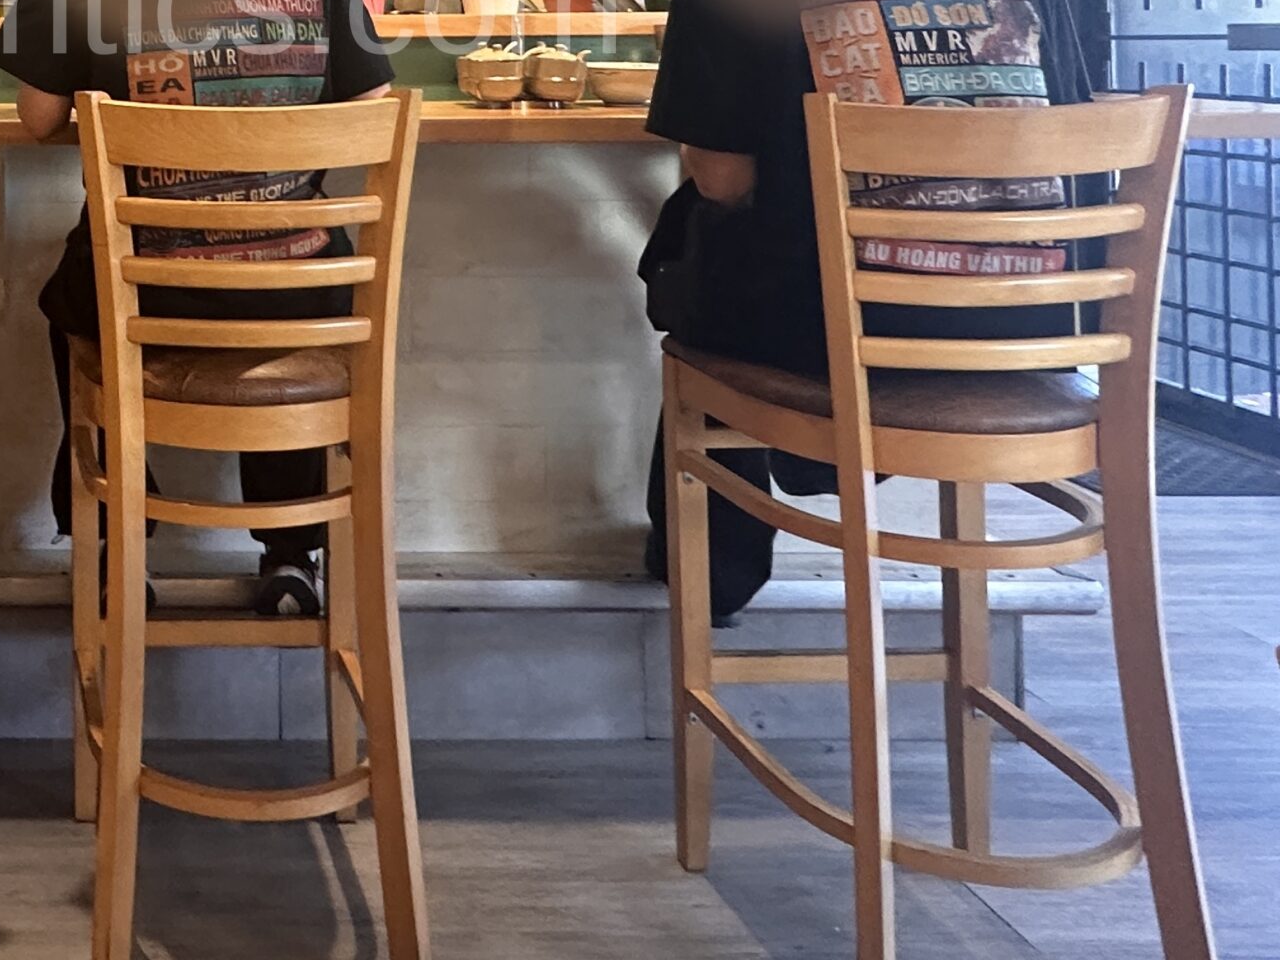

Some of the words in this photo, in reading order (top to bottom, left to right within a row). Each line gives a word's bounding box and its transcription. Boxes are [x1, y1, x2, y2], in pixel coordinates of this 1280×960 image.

[821, 37, 882, 78] CÁT
[900, 52, 970, 66] MAVERICK
[194, 67, 238, 78] MAVERICK
[137, 77, 185, 95] EA
[896, 245, 961, 270] HOÀNG
